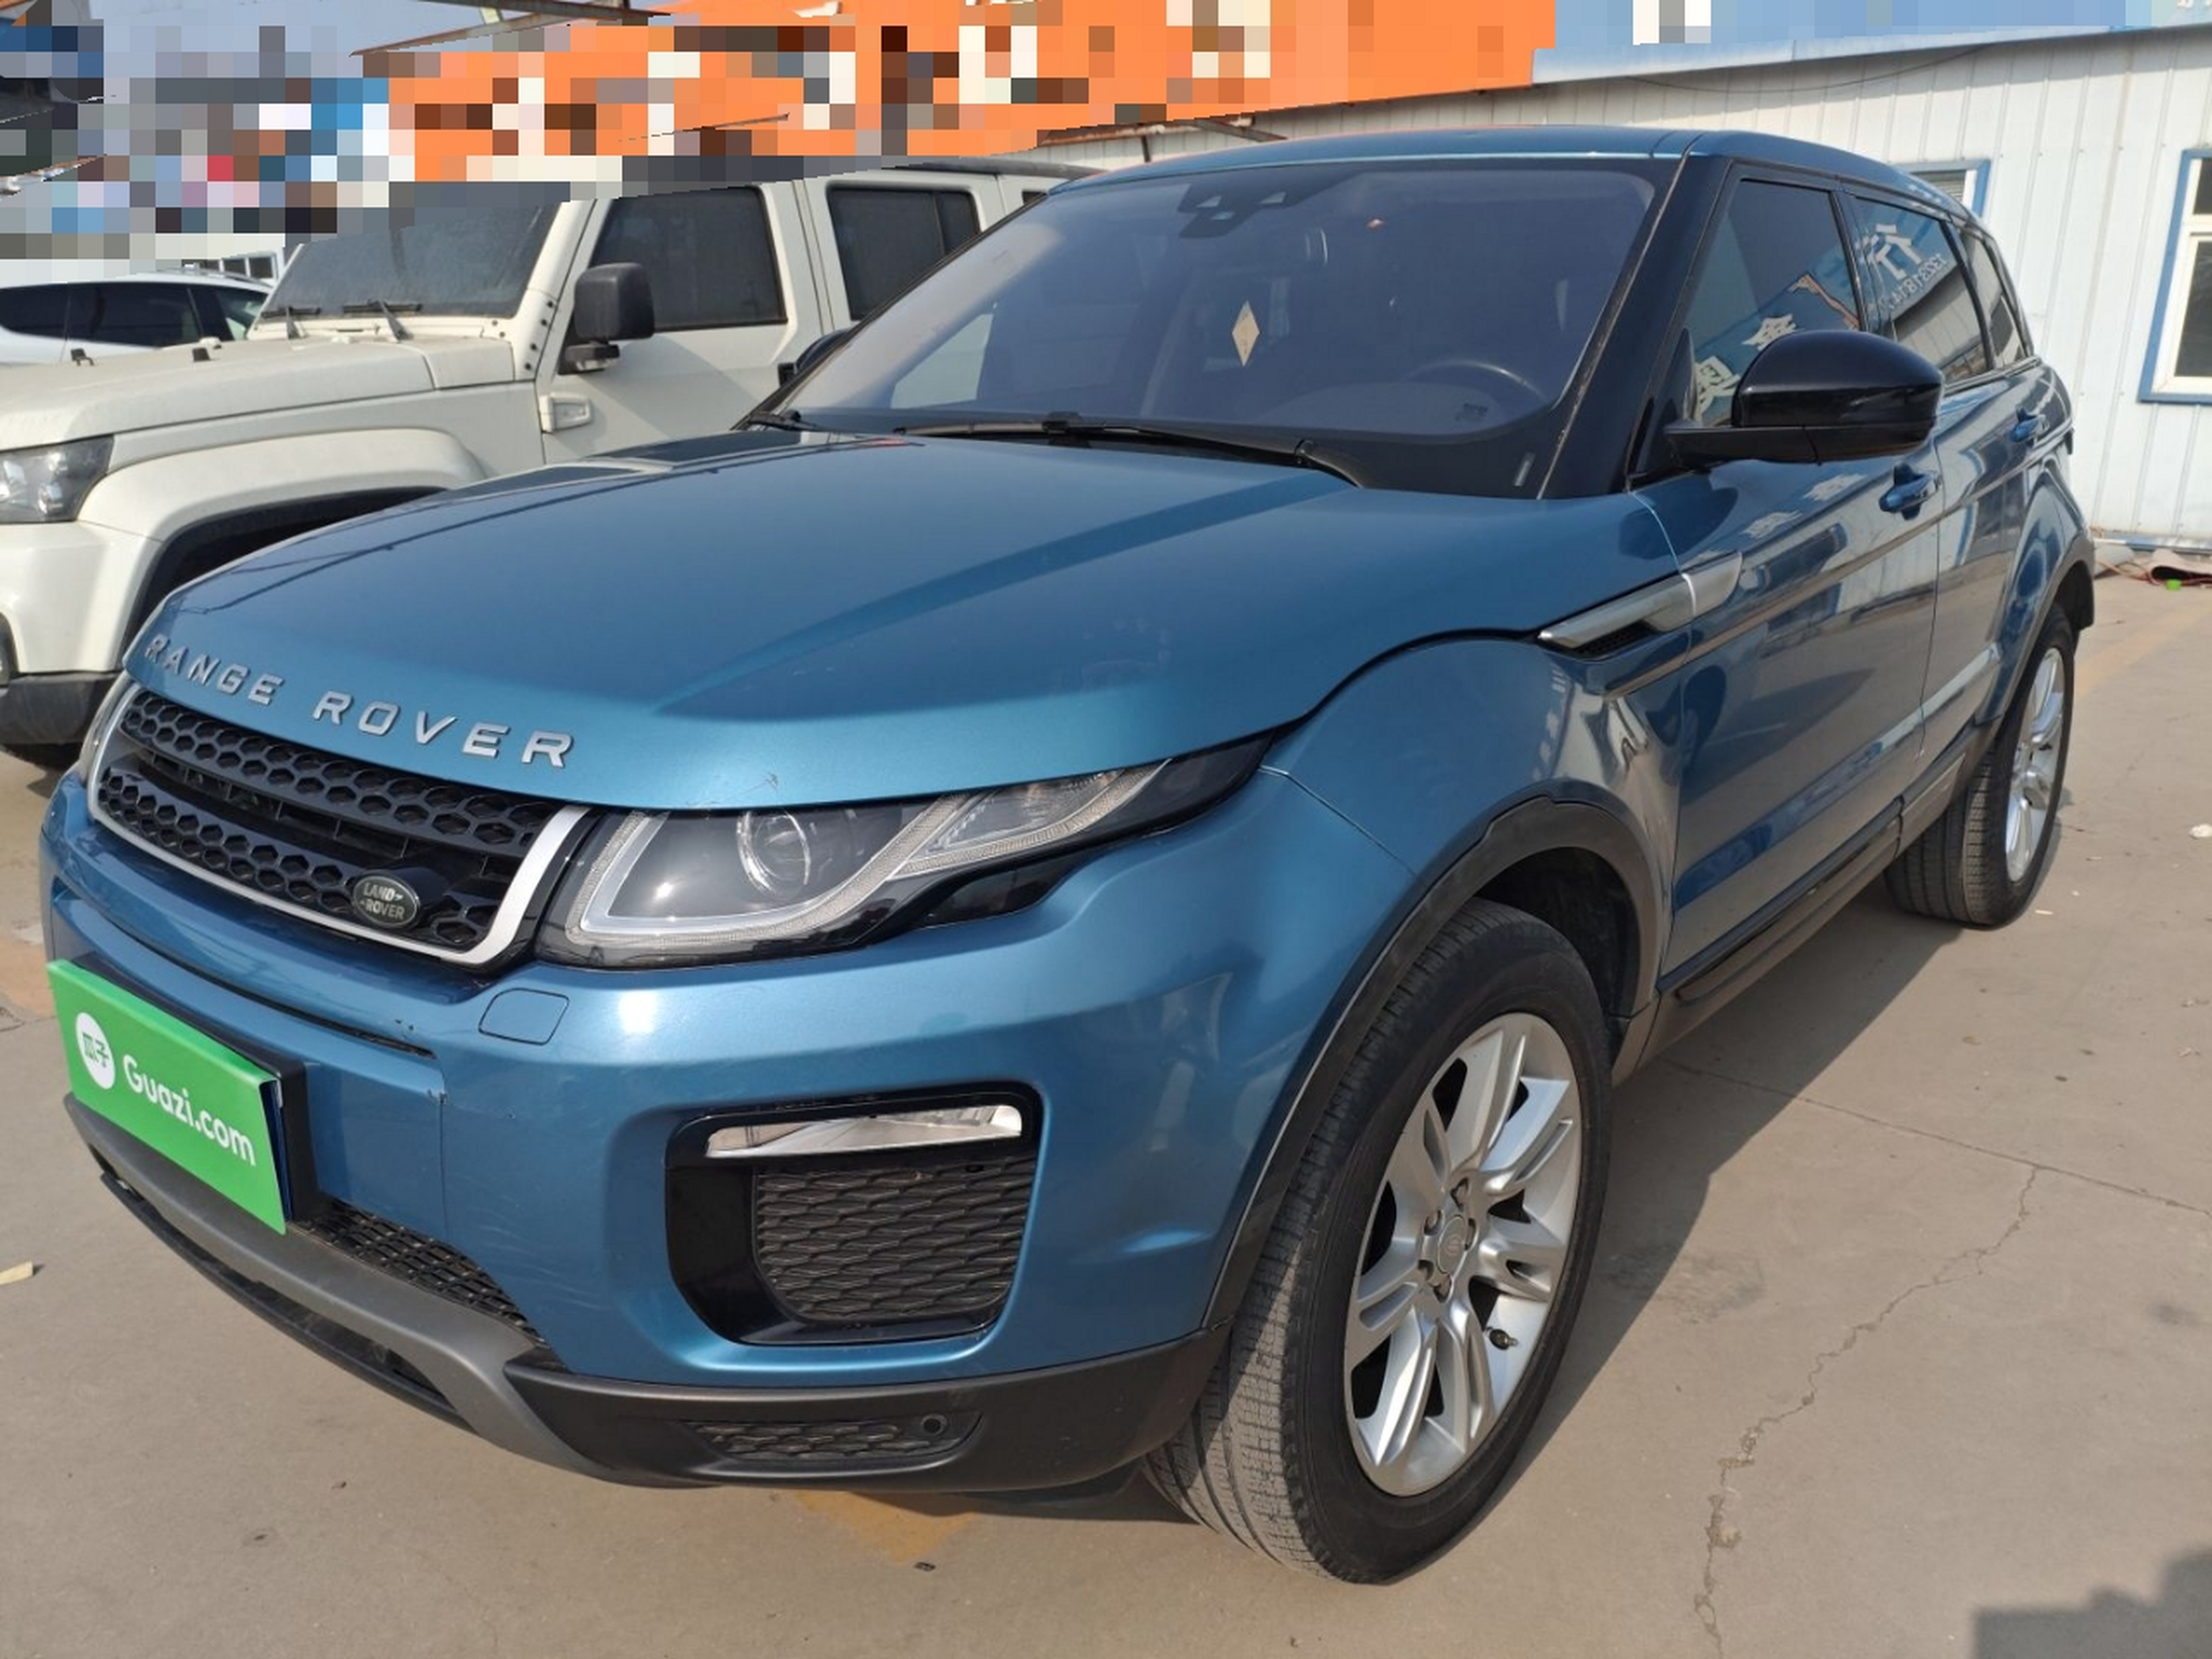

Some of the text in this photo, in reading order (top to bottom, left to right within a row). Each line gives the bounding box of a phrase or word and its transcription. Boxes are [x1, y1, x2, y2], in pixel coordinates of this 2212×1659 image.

[145, 634, 574, 768] RANGE ROVER
[363, 882, 396, 902] LAND
[365, 898, 405, 921] ROVER
[123, 1054, 256, 1167] Guazi.com
